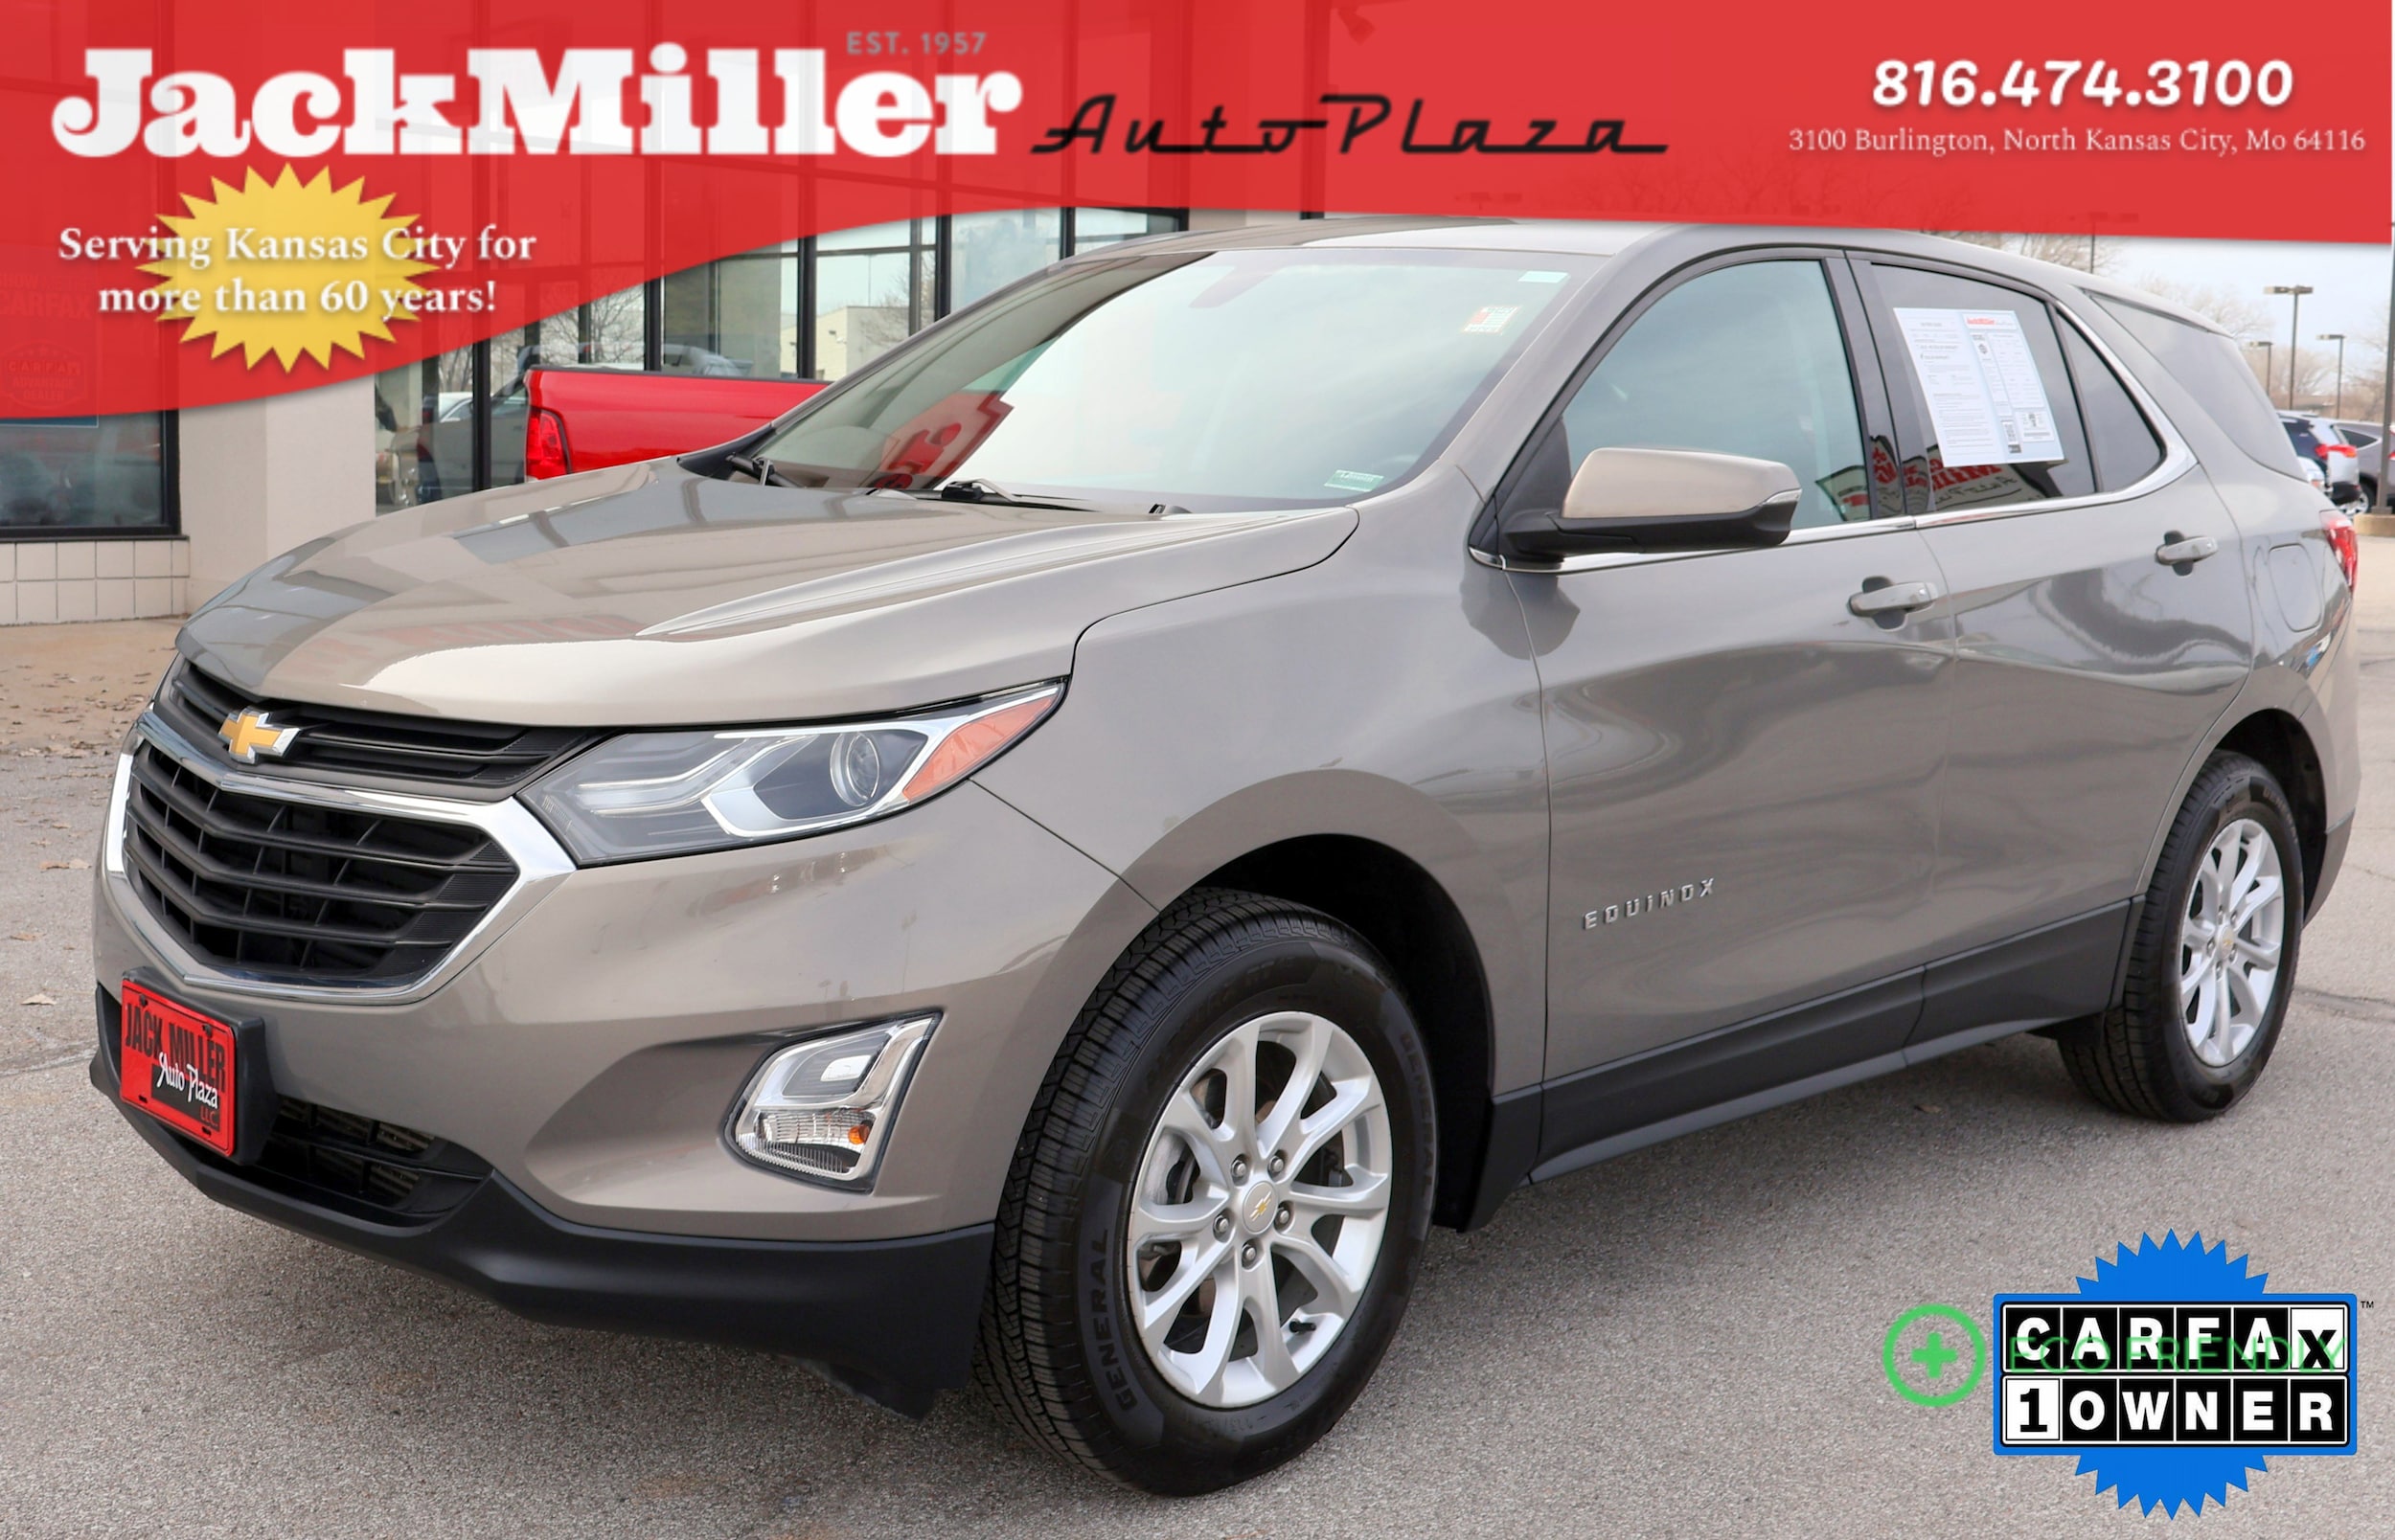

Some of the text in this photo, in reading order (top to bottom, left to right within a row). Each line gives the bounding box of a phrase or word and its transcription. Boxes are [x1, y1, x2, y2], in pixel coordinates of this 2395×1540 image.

[1583, 877, 1714, 930] EQUINOX
[125, 1004, 226, 1094] JACK MILLER
[156, 1051, 219, 1108] Auto Plaza
[1089, 1229, 1138, 1412] GENERAL
